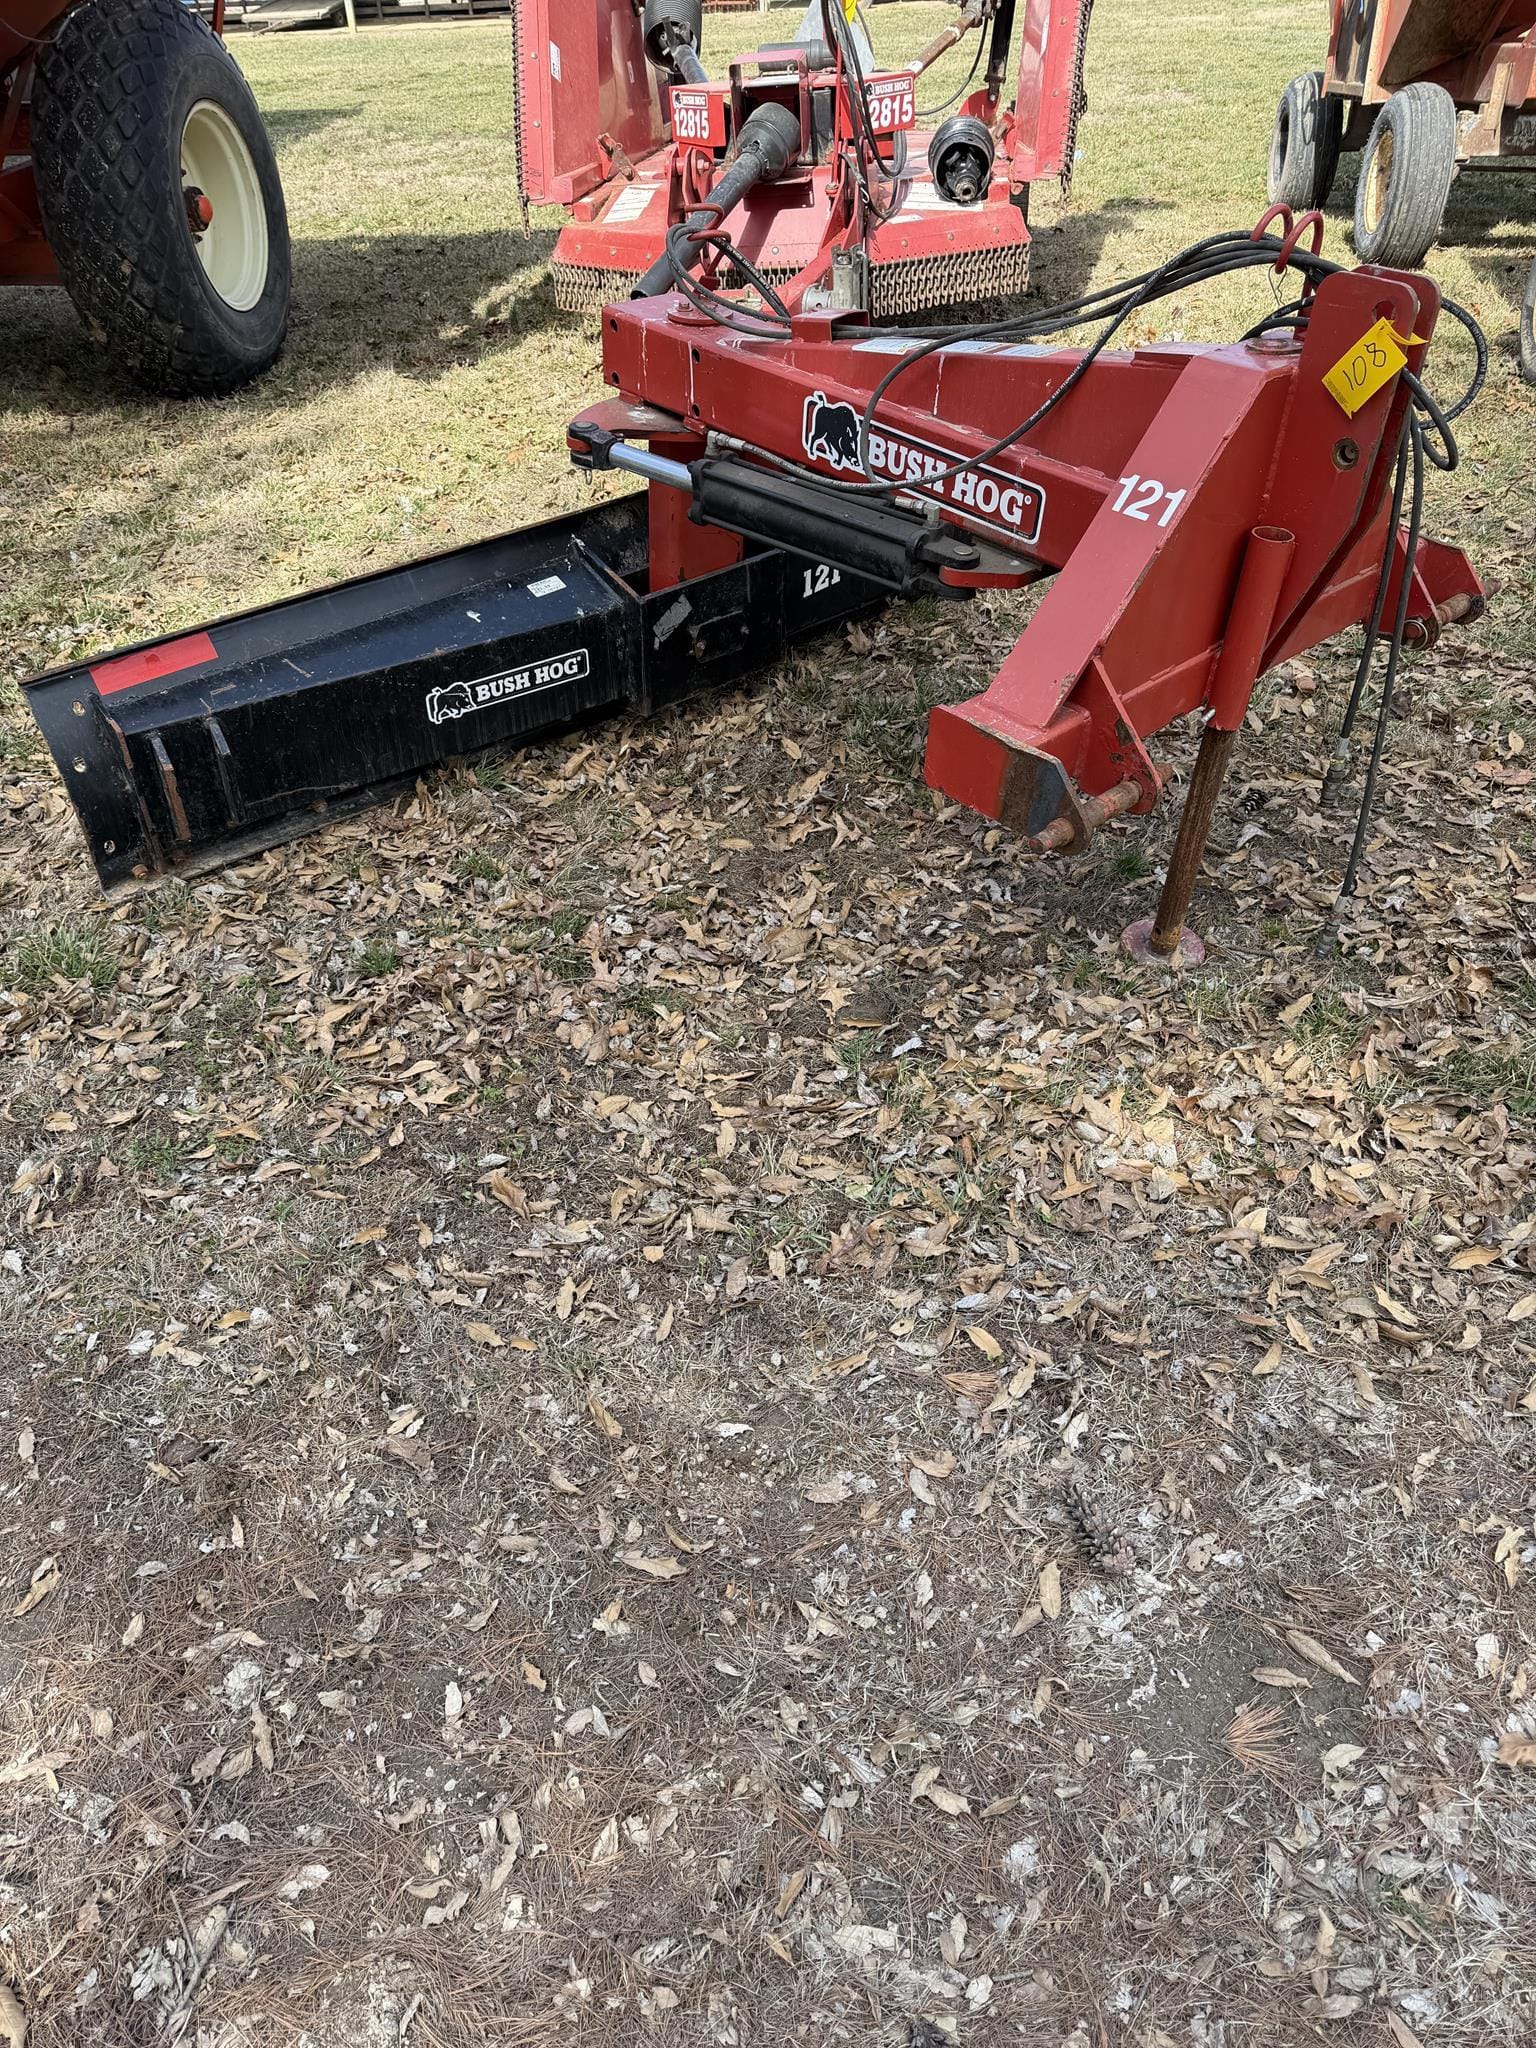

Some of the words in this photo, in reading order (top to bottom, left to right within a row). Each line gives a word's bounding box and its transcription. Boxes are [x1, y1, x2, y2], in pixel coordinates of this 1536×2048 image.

[682, 95, 694, 106] BUSH
[695, 96, 706, 106] HOG
[875, 83, 893, 95] BUSH
[894, 80, 910, 91] HOG
[674, 109, 709, 140] 12815
[869, 94, 913, 128] 2815
[1342, 342, 1387, 391] 108
[868, 432, 948, 494] BUSH
[952, 471, 1028, 525] HOG
[1111, 473, 1187, 527] 121
[475, 671, 532, 702] BUSH
[534, 657, 579, 684] HOG
